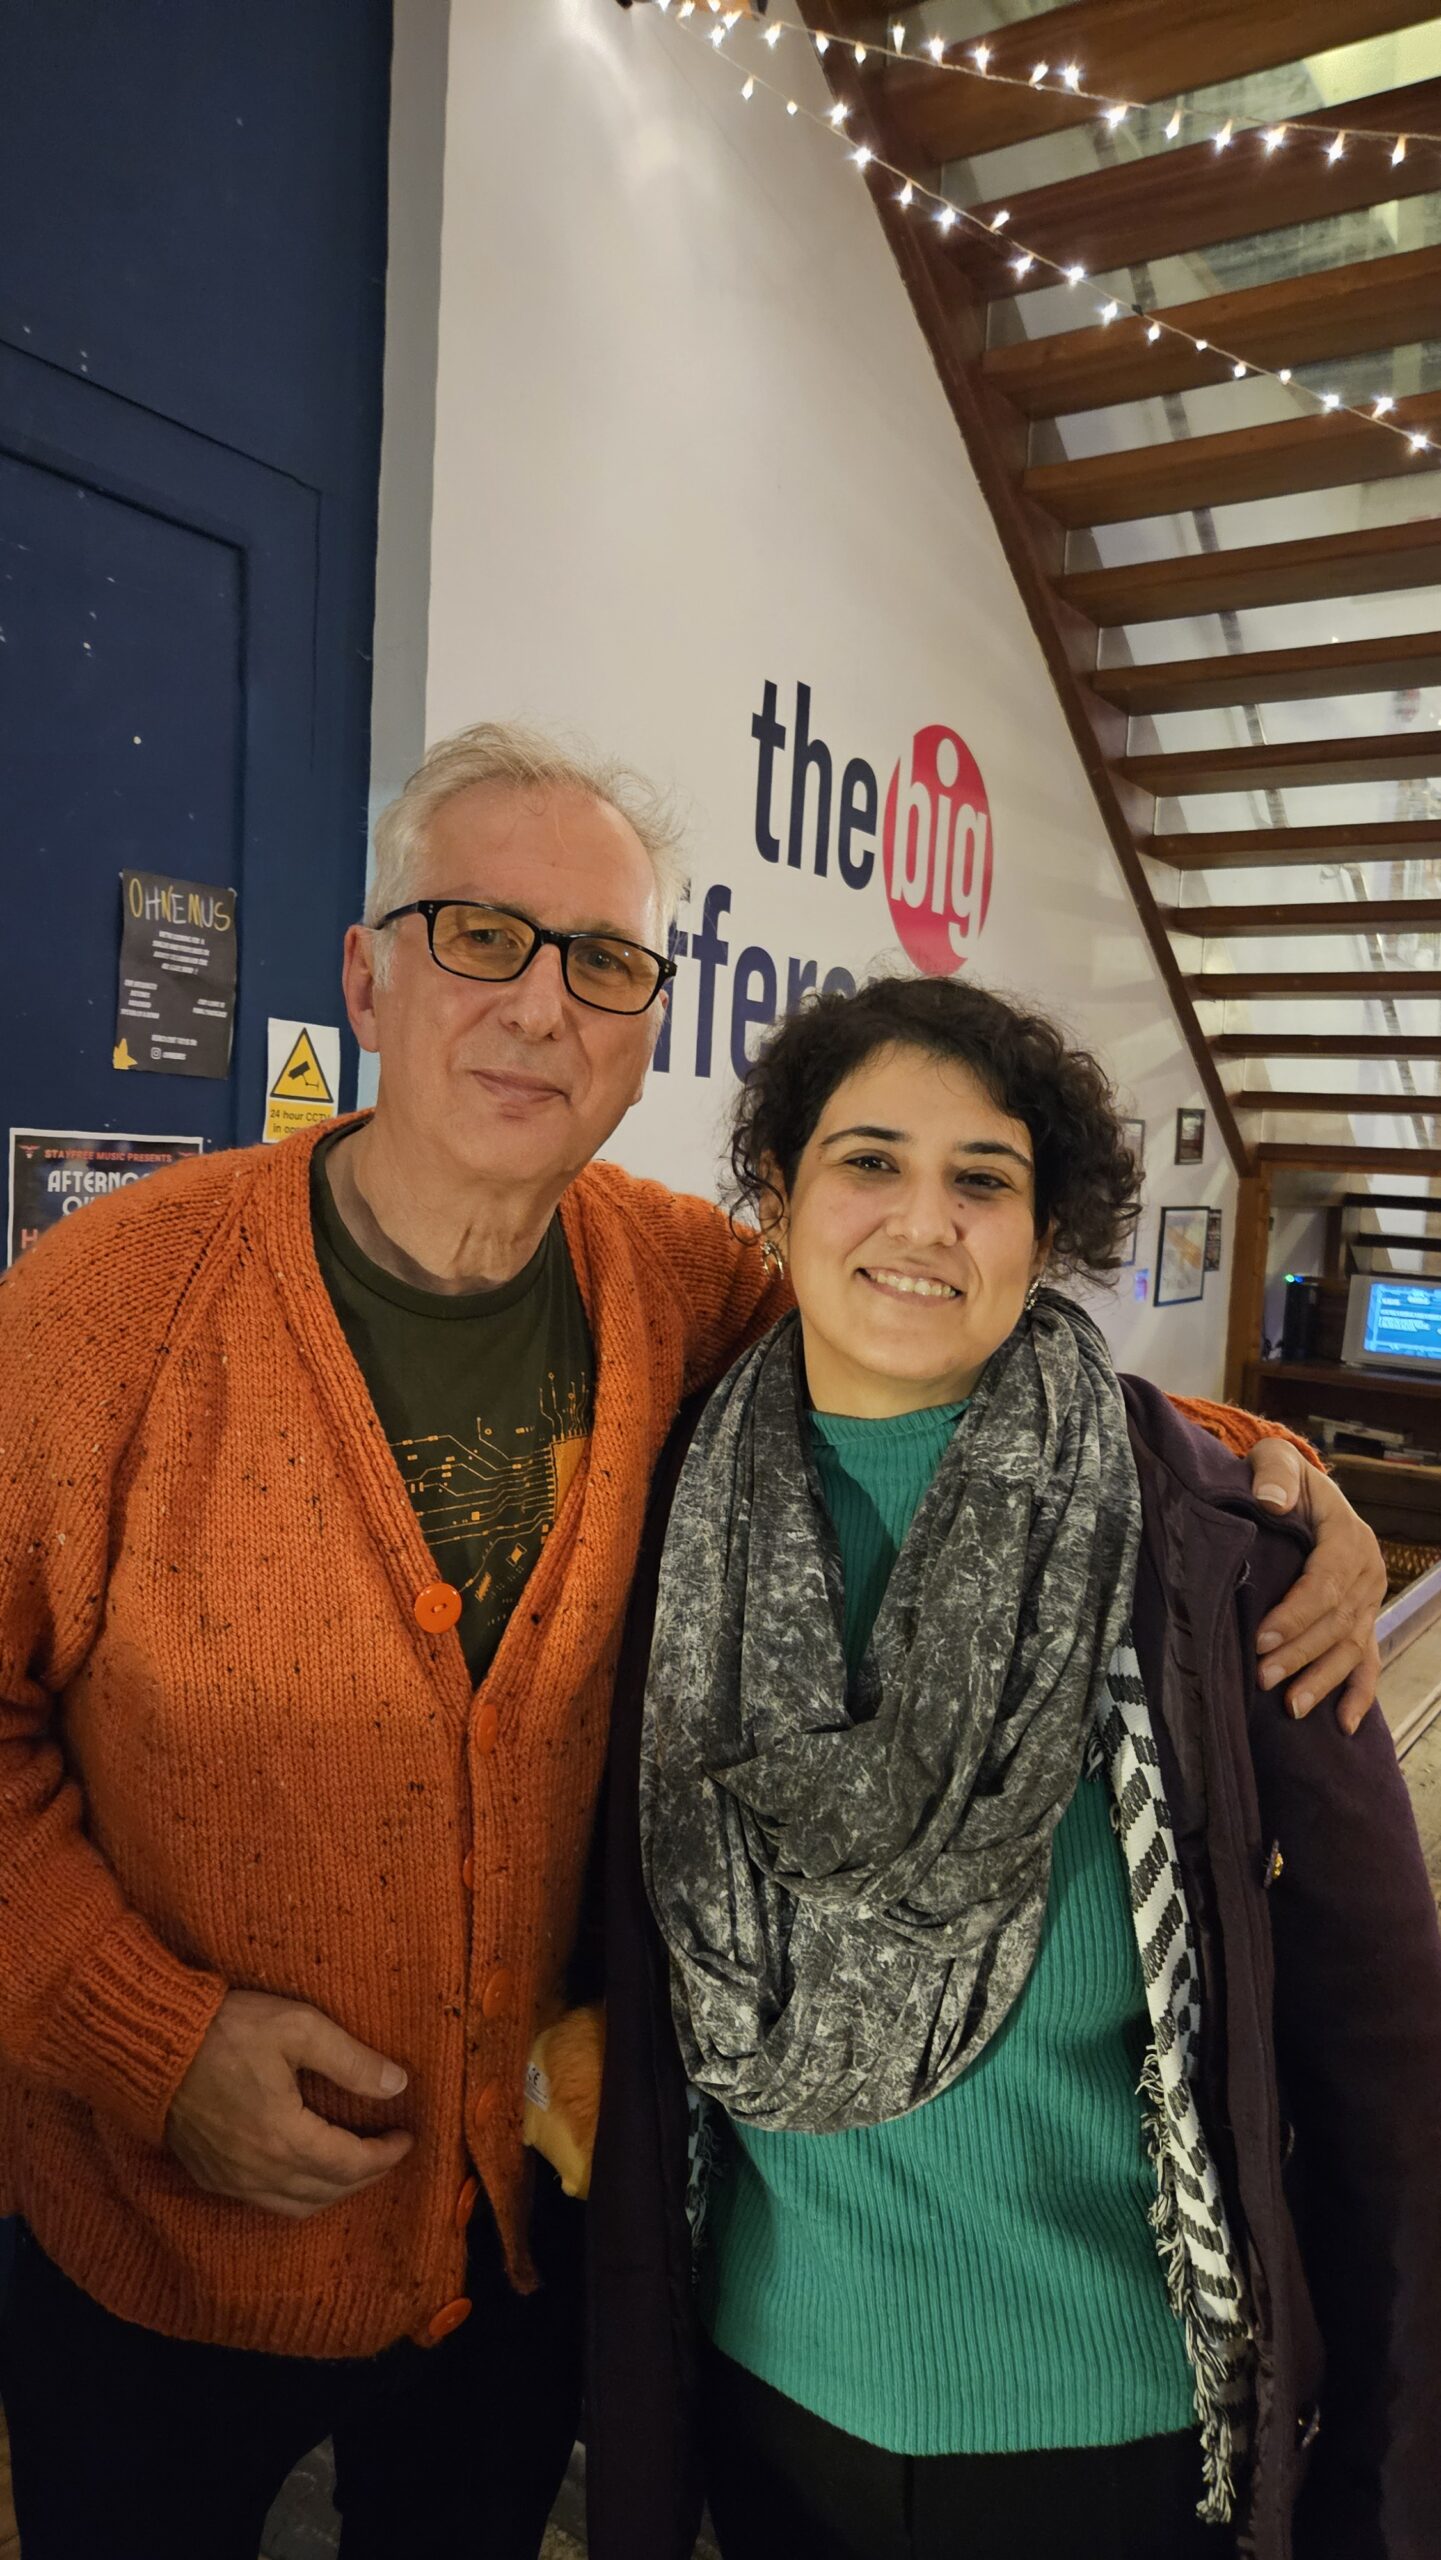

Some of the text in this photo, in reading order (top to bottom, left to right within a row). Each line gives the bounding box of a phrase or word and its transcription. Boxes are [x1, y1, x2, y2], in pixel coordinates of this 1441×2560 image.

[751, 679, 988, 960] the big
[270, 1109, 281, 1119] 24
[283, 1110, 304, 1121] hour
[272, 1123, 282, 1133] in
[44, 1149, 173, 1163] STAYFREE MUSIC PRESENTS
